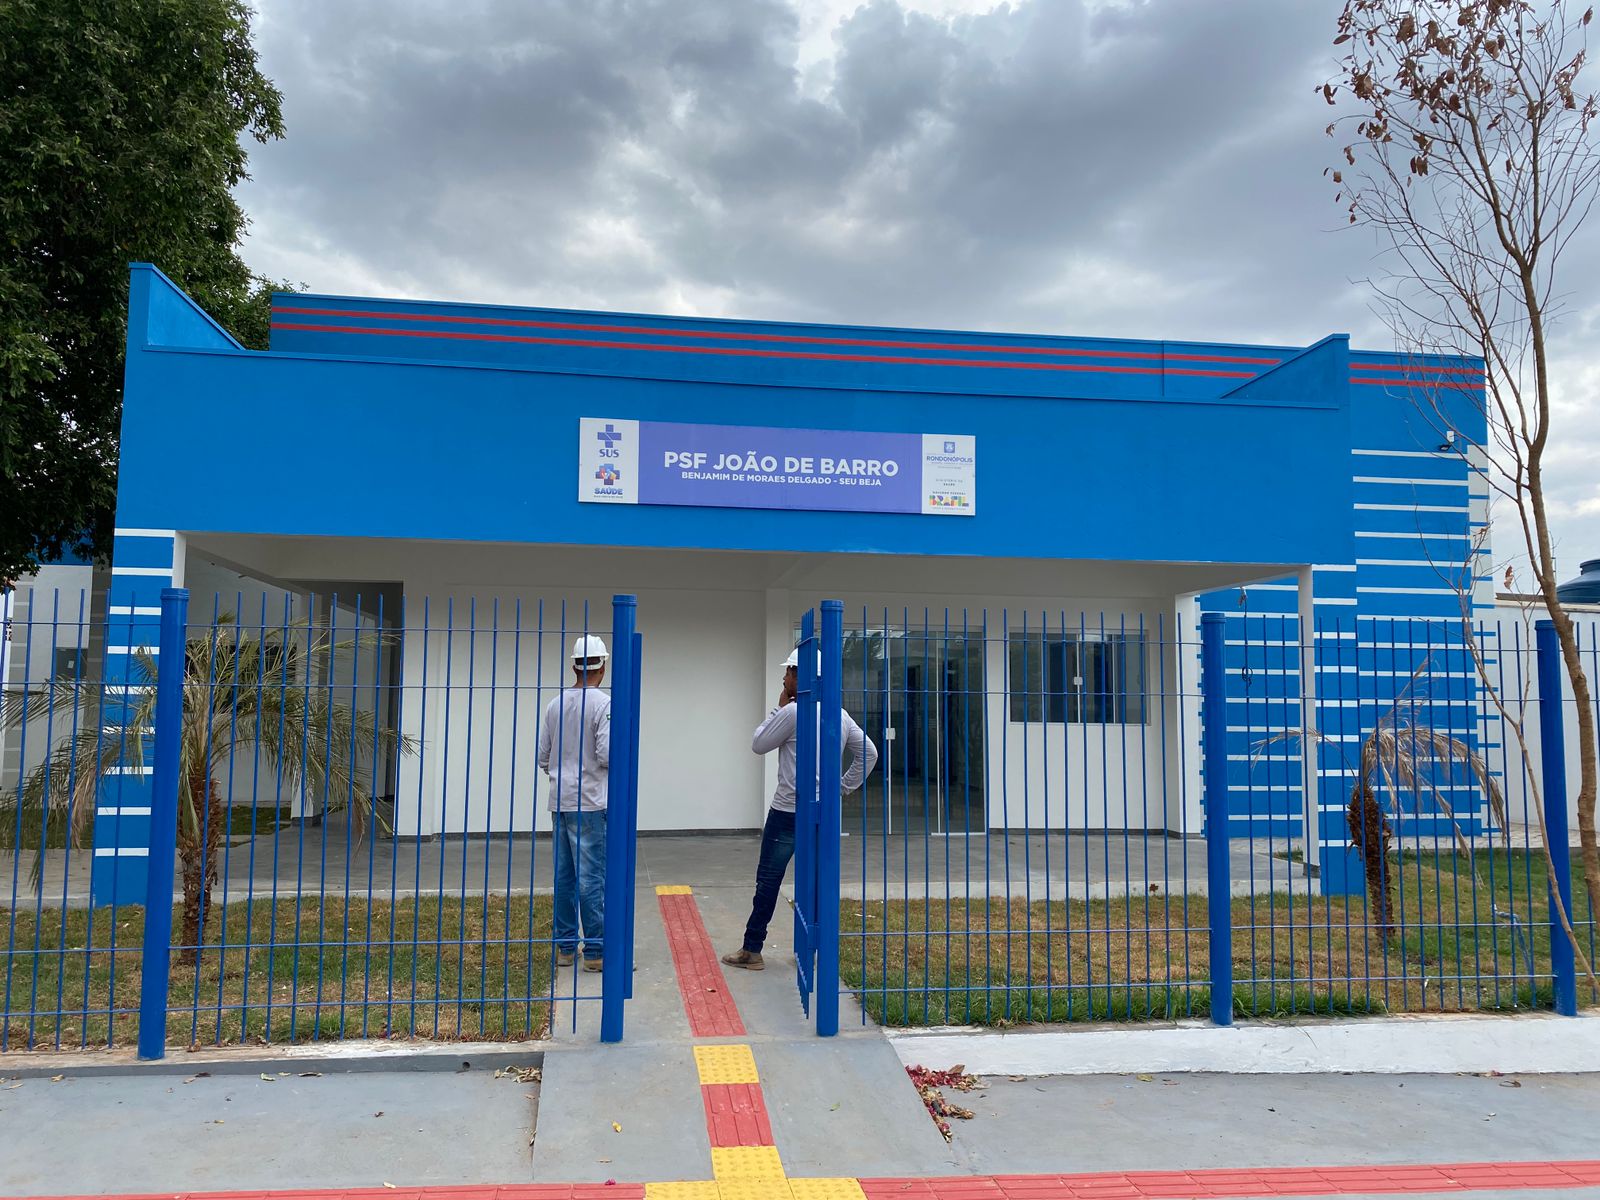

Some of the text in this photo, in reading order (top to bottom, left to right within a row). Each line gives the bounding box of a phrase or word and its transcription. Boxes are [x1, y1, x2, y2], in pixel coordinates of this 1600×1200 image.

[599, 448, 619, 458] SUS
[664, 451, 899, 477] PSF JOÃO DE BARRO
[682, 471, 730, 480] BENJAMIM
[747, 474, 785, 483] MORAES
[788, 476, 831, 484] DELGADO
[859, 478, 881, 486] BEJA
[594, 487, 623, 495] SAÚDE
